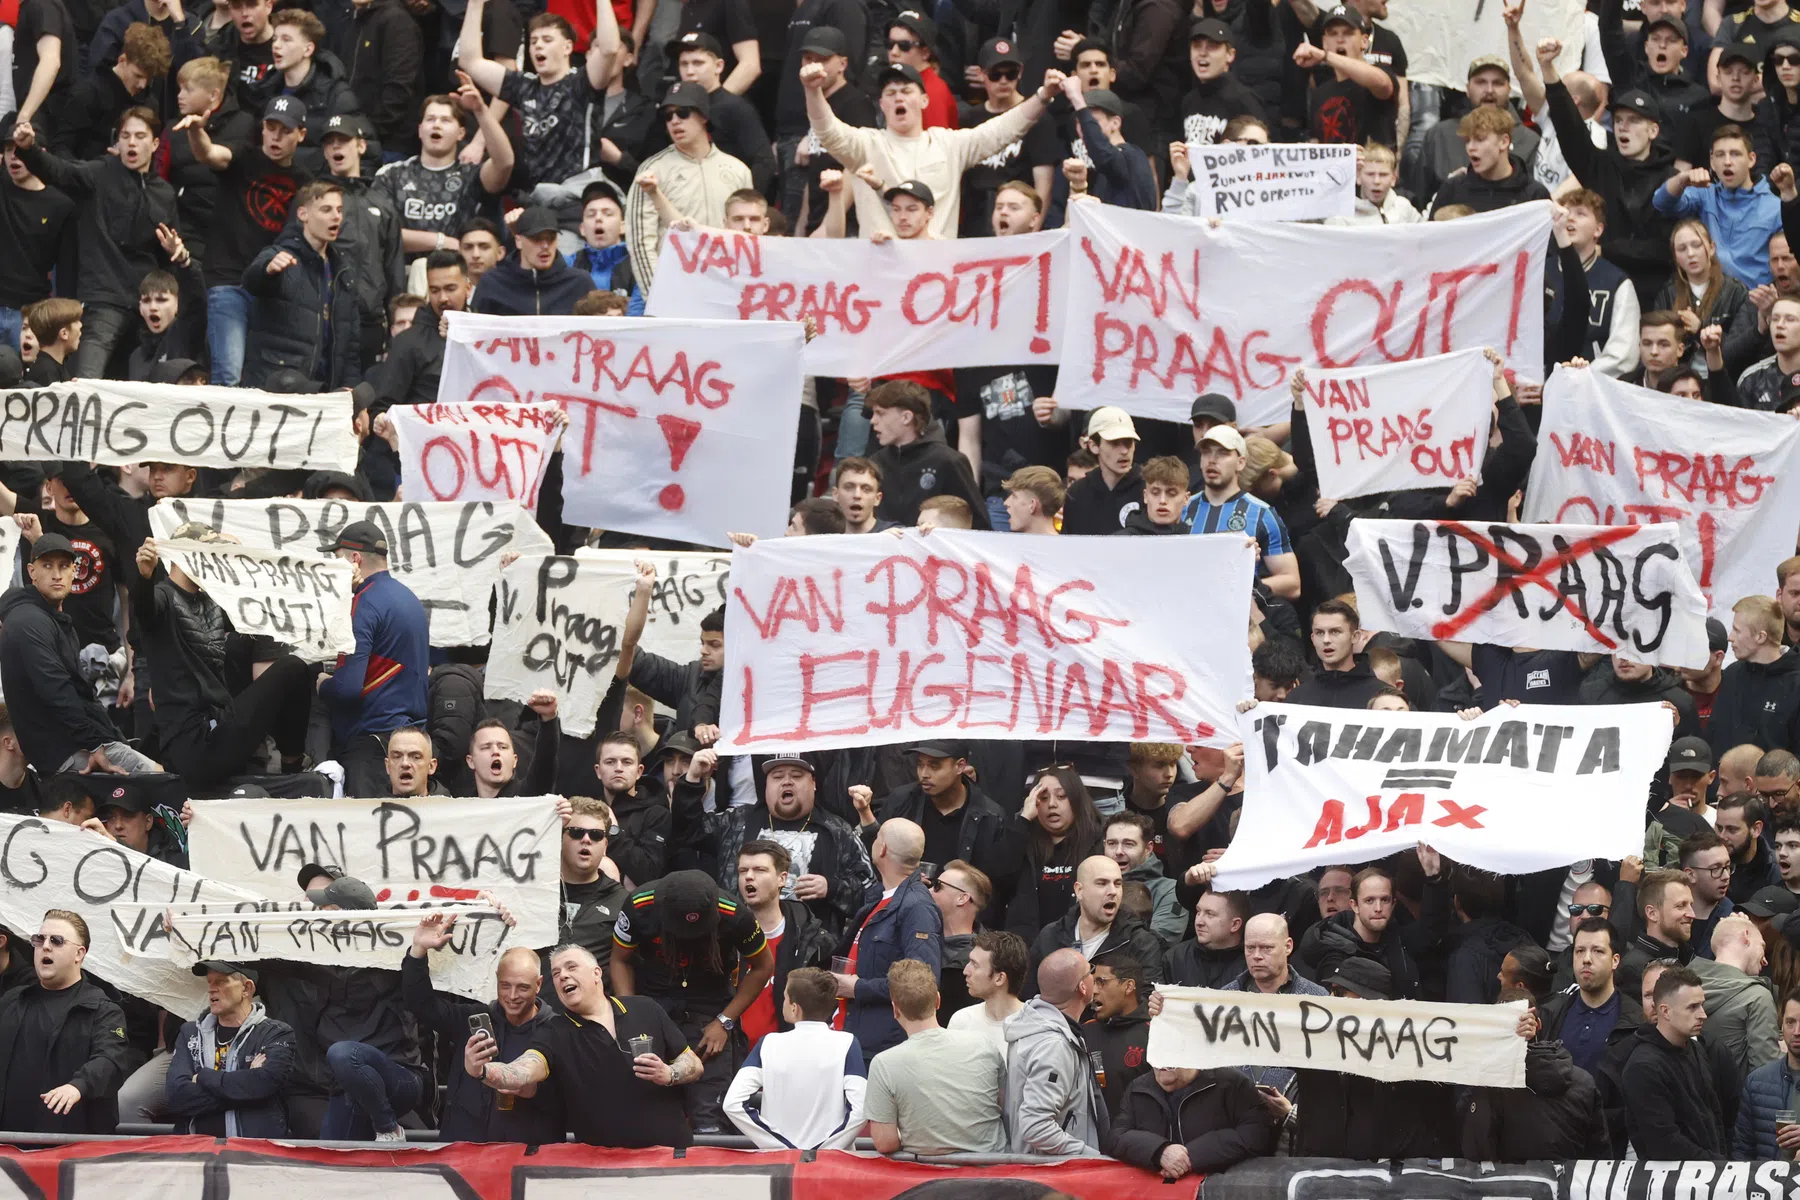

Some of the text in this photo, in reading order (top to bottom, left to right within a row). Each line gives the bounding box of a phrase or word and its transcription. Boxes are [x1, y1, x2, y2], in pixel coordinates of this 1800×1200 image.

[1204, 149, 1247, 171] DOOR
[404, 198, 457, 220] Ziggo
[1215, 190, 1256, 214] RVC
[669, 232, 763, 278] VAN
[1081, 236, 1200, 320] VAN
[737, 251, 1052, 354] PRAAG OUT!
[1093, 251, 1529, 401] PRAAG OUT!
[563, 331, 735, 409] PRAAG
[1304, 377, 1371, 413] VAN
[0, 391, 325, 466] PRAAG OUT!
[413, 403, 469, 425] VAN
[1327, 408, 1433, 465] PRAAG
[1550, 431, 1776, 509] VAN PRAAG
[184, 553, 341, 599] VAN PRAAG
[734, 568, 843, 640] VAN
[864, 554, 1131, 649] PRAAG
[237, 596, 328, 650] OUT!
[733, 648, 1216, 743] LEUGENAAR.
[1253, 713, 1621, 776] TAHAMATA
[239, 801, 542, 884] VAN PRAAG
[1302, 793, 1489, 849] AJAX
[172, 920, 260, 960] VAN
[287, 918, 404, 953] PRAAG
[1193, 1000, 1459, 1068] VAN PRAAG
